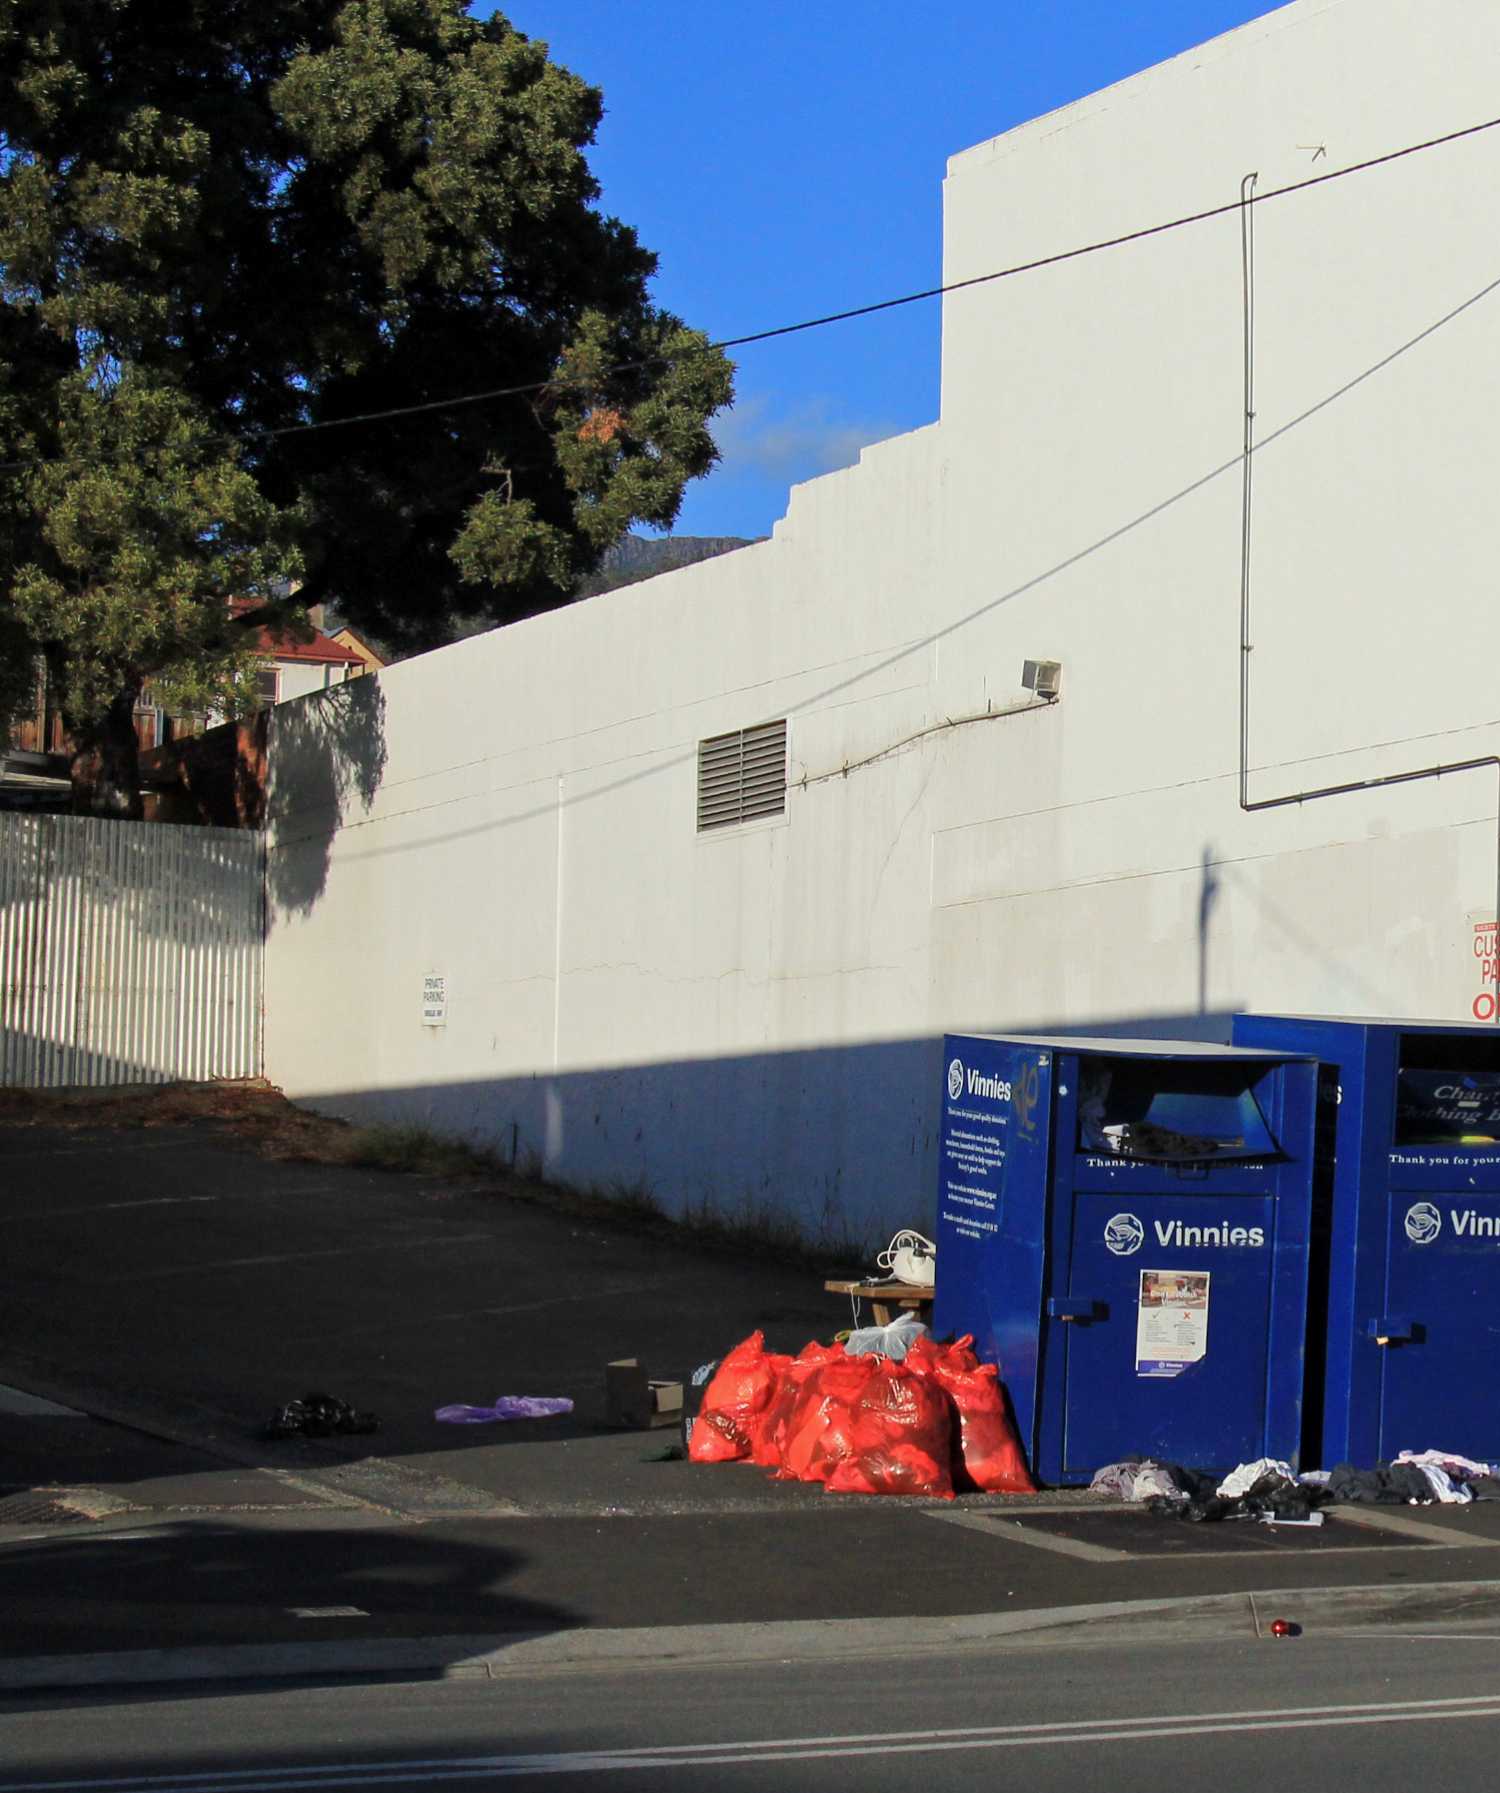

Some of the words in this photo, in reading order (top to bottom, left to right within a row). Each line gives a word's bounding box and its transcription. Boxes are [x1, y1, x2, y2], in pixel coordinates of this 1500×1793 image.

[967, 1067, 1012, 1102] Vinnies
[1086, 1157, 1127, 1168] Thank
[1388, 1154, 1425, 1165] Thank
[1429, 1155, 1449, 1167] you
[1453, 1156, 1470, 1166] for
[1153, 1220, 1265, 1248] Vinnies
